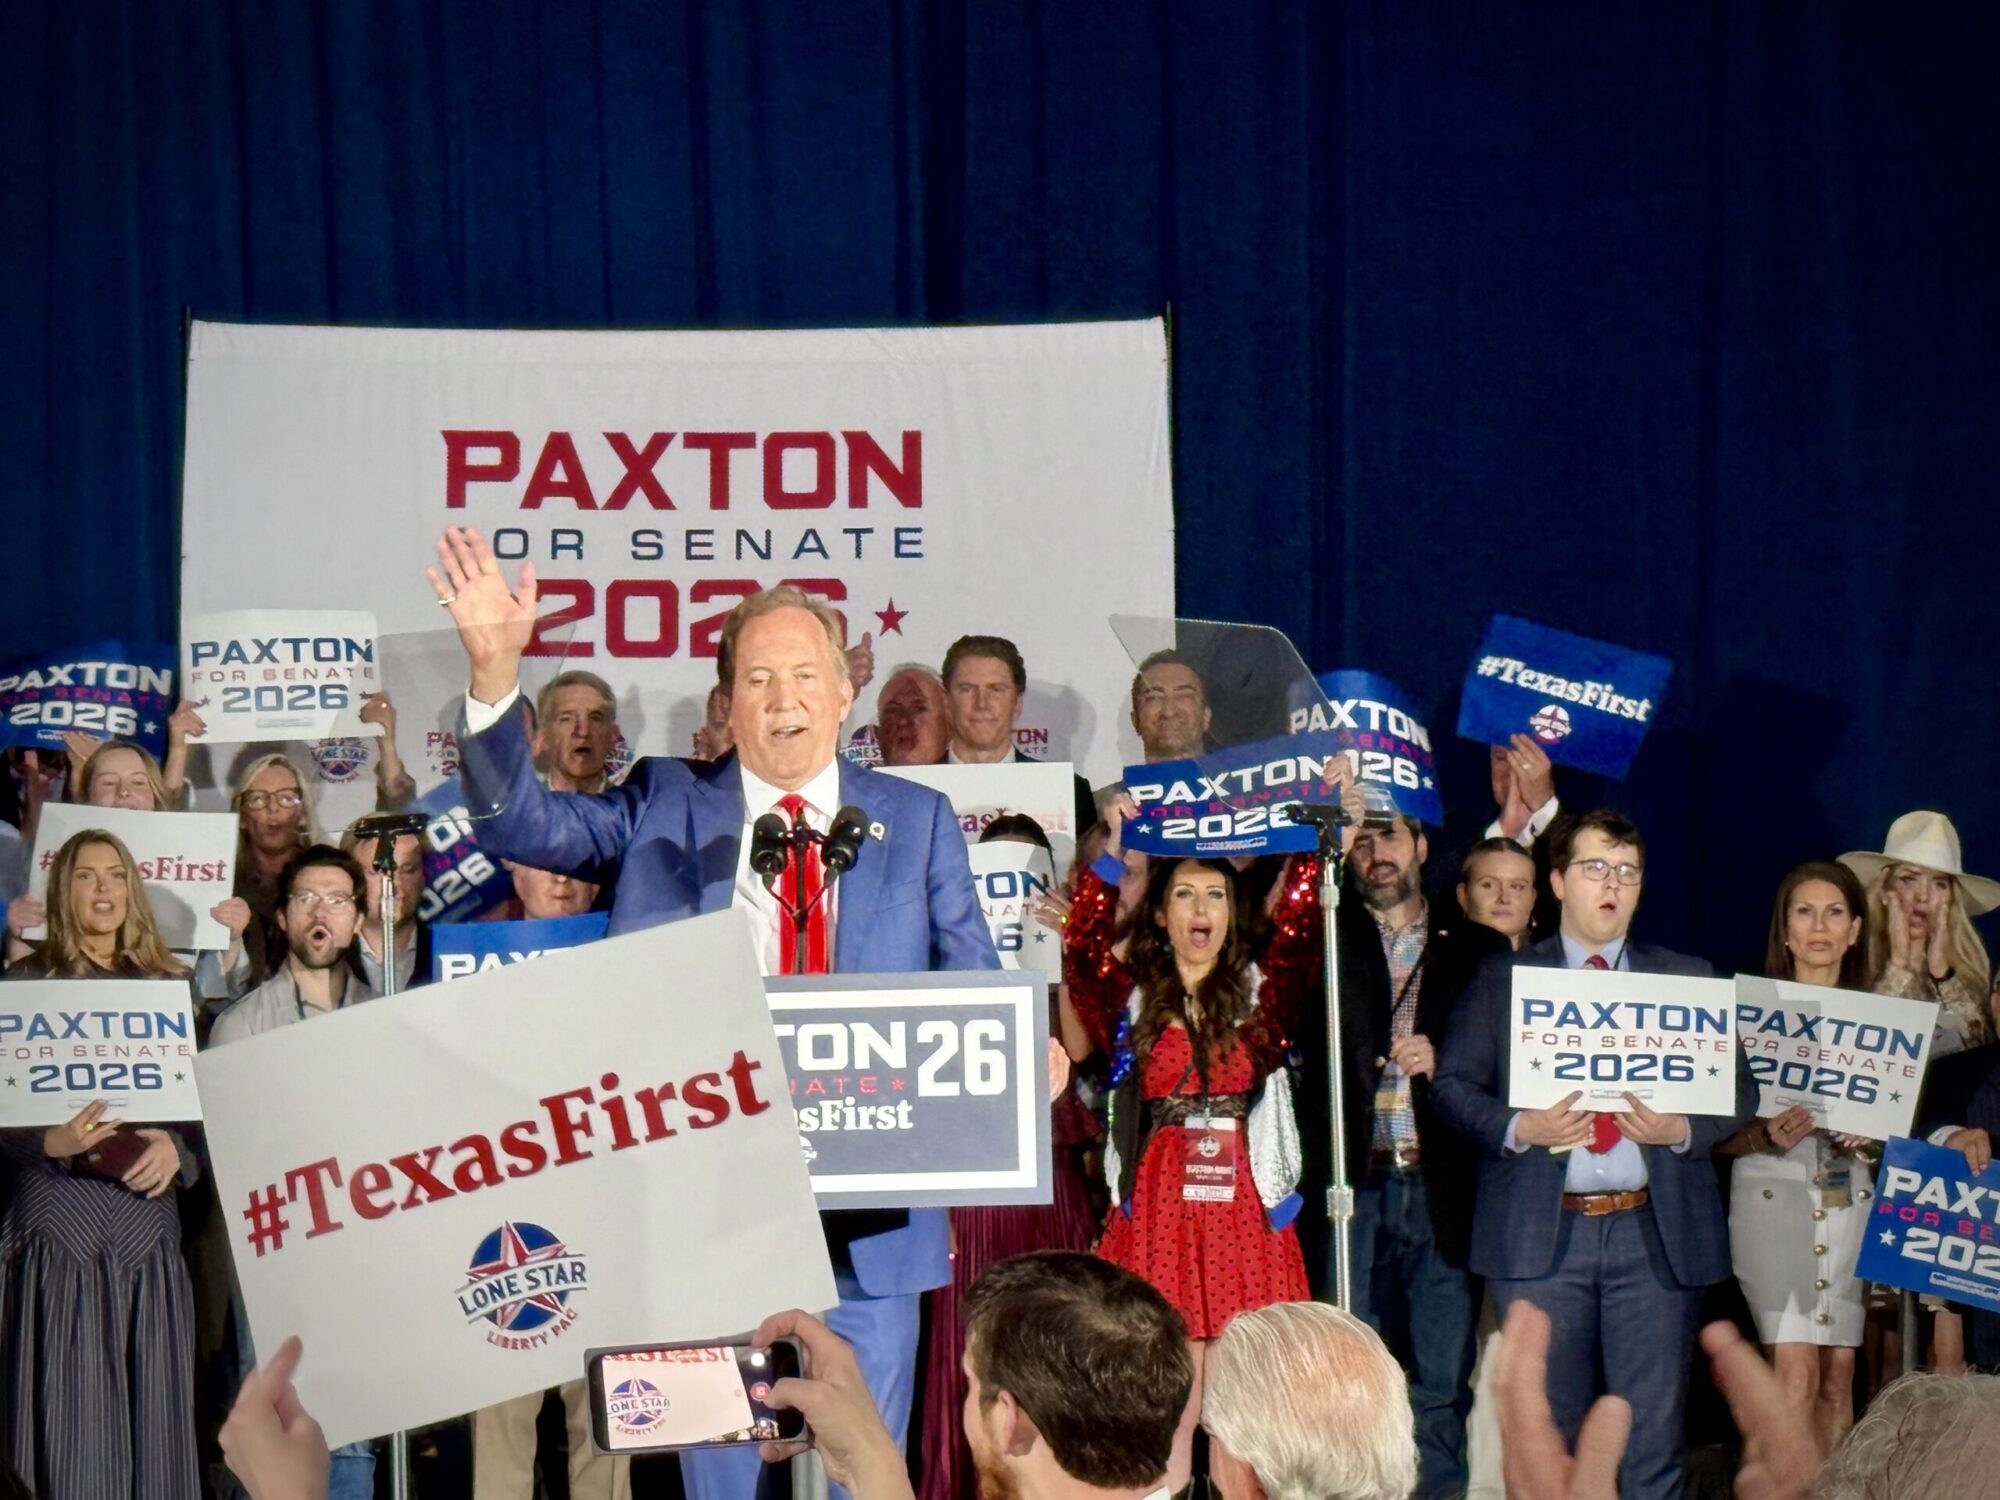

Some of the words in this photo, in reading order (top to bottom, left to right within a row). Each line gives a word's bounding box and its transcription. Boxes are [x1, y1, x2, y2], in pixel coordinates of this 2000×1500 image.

[441, 430, 922, 510] PAXTON
[493, 528, 584, 560] OR
[631, 527, 924, 560] SENATE
[190, 637, 373, 668] PAXTON
[192, 670, 246, 683] FOR
[262, 667, 375, 681] SENATE
[1477, 655, 1653, 722] #TexasFirst
[222, 684, 349, 713] 2026
[9, 700, 138, 736] 2026
[1290, 698, 1433, 753] PAXTON
[1128, 756, 1332, 806] PAXTON
[1521, 998, 1728, 1035] PAXTON
[1736, 1003, 1924, 1060] PAXTON
[73, 1044, 191, 1057] SENATE
[917, 1019, 1007, 1097] 26
[1521, 1031, 1582, 1047] FOR
[1601, 1035, 1729, 1053] SENATE
[1743, 1036, 1779, 1053] OR
[1796, 1045, 1917, 1079] SENATE
[29, 1063, 163, 1093] 2026
[1554, 1052, 1695, 1082] 2026
[1748, 1055, 1880, 1105] 2026
[795, 1096, 914, 1132] sFirst
[243, 1050, 770, 1258] #TexasFirst
[458, 1273, 522, 1316] LONE
[525, 1261, 587, 1291] STAR
[486, 1330, 548, 1350] LIBERTY
